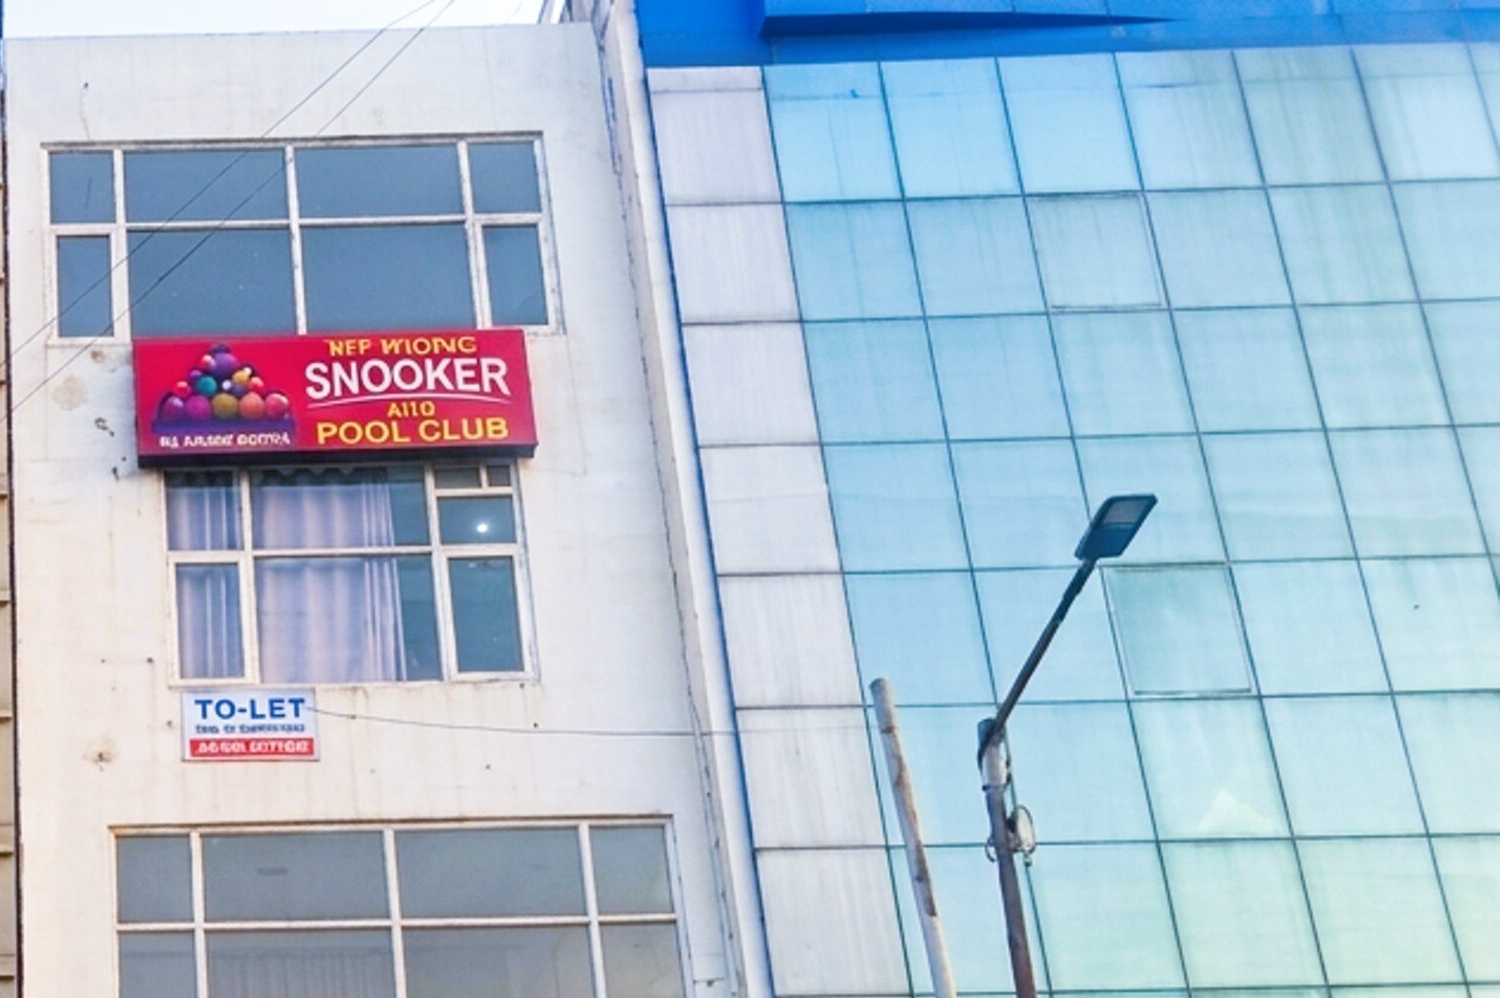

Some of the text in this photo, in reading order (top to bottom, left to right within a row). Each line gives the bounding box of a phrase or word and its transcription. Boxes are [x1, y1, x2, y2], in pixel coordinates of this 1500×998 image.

[305, 356, 511, 400] SNOOKER
[317, 421, 411, 445] POOL
[418, 416, 510, 442] CLUB
[194, 697, 306, 720] TO-LET
